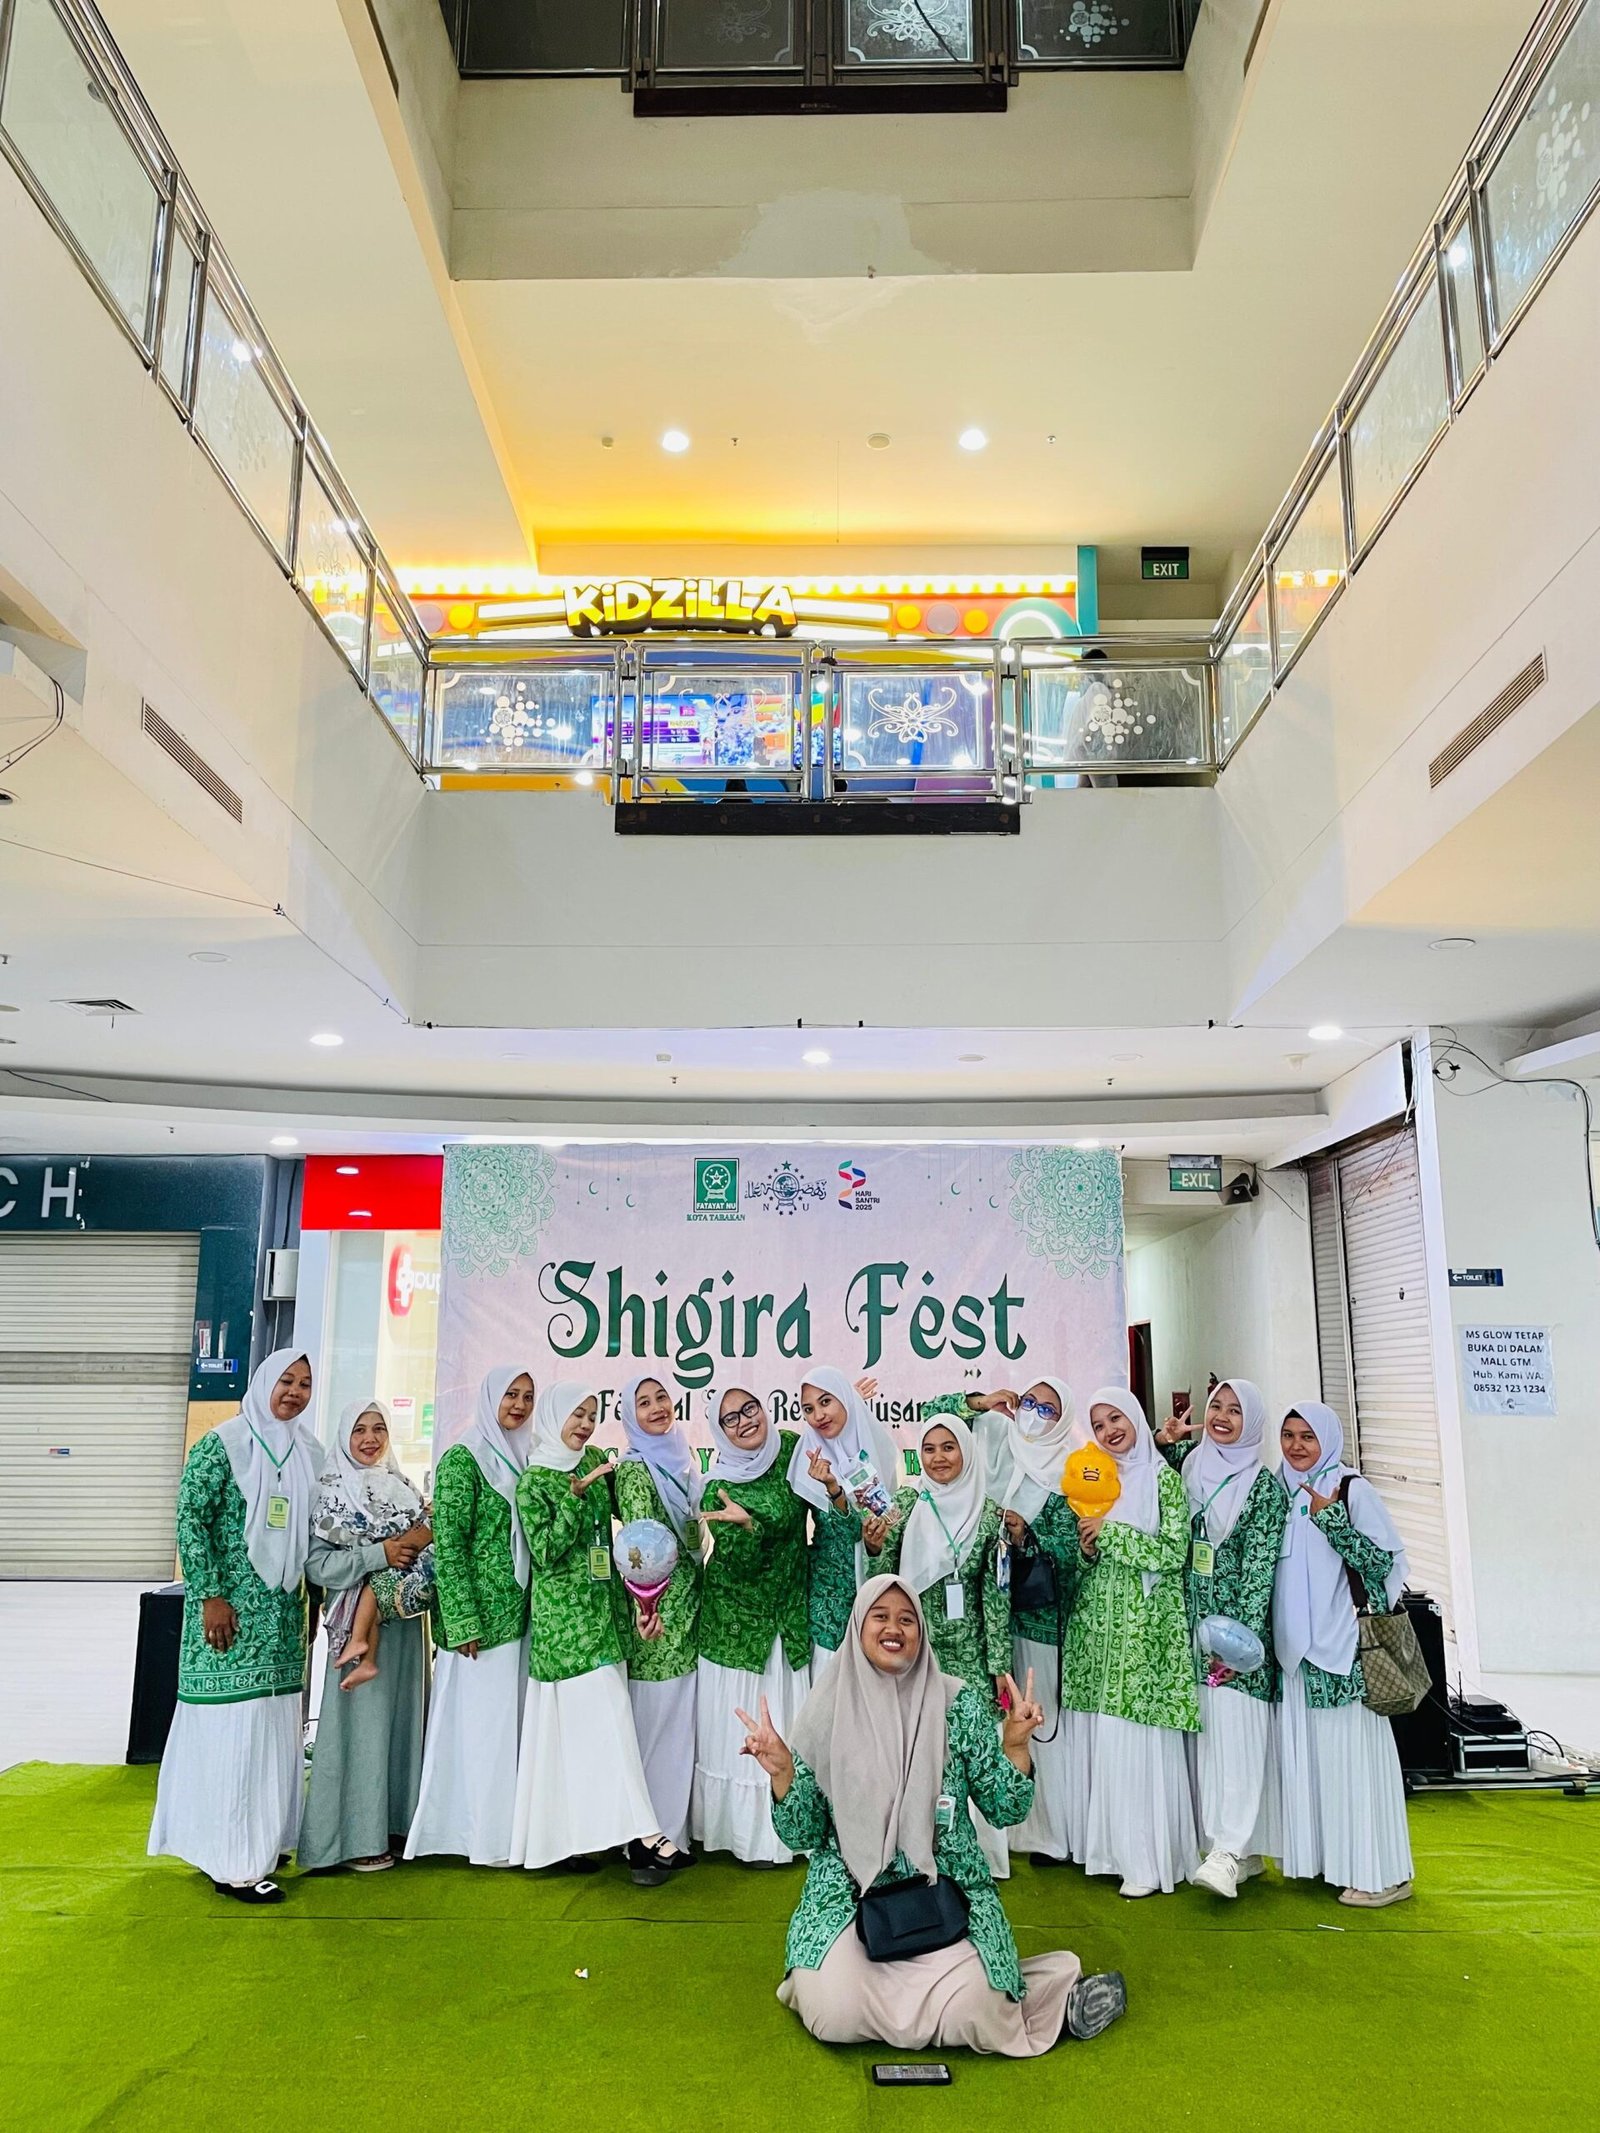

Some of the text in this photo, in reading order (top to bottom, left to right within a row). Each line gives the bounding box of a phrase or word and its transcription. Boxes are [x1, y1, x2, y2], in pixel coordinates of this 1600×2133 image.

[1153, 563, 1179, 577] EXIT
[1181, 1172, 1211, 1188] EXIT
[696, 1202, 736, 1210] FATAYAT NU
[686, 1213, 708, 1221] KOTA
[538, 1261, 1027, 1388] Shigira Fest
[1465, 1330, 1544, 1340] MS GLOW TETAP
[1467, 1343, 1495, 1353] BUKA
[1497, 1343, 1507, 1353] DI
[1480, 1357, 1507, 1366] MALL
[1472, 1370, 1495, 1379] Hub.
[1498, 1370, 1523, 1380] Kami
[1473, 1383, 1546, 1393] 08532 123 1234
